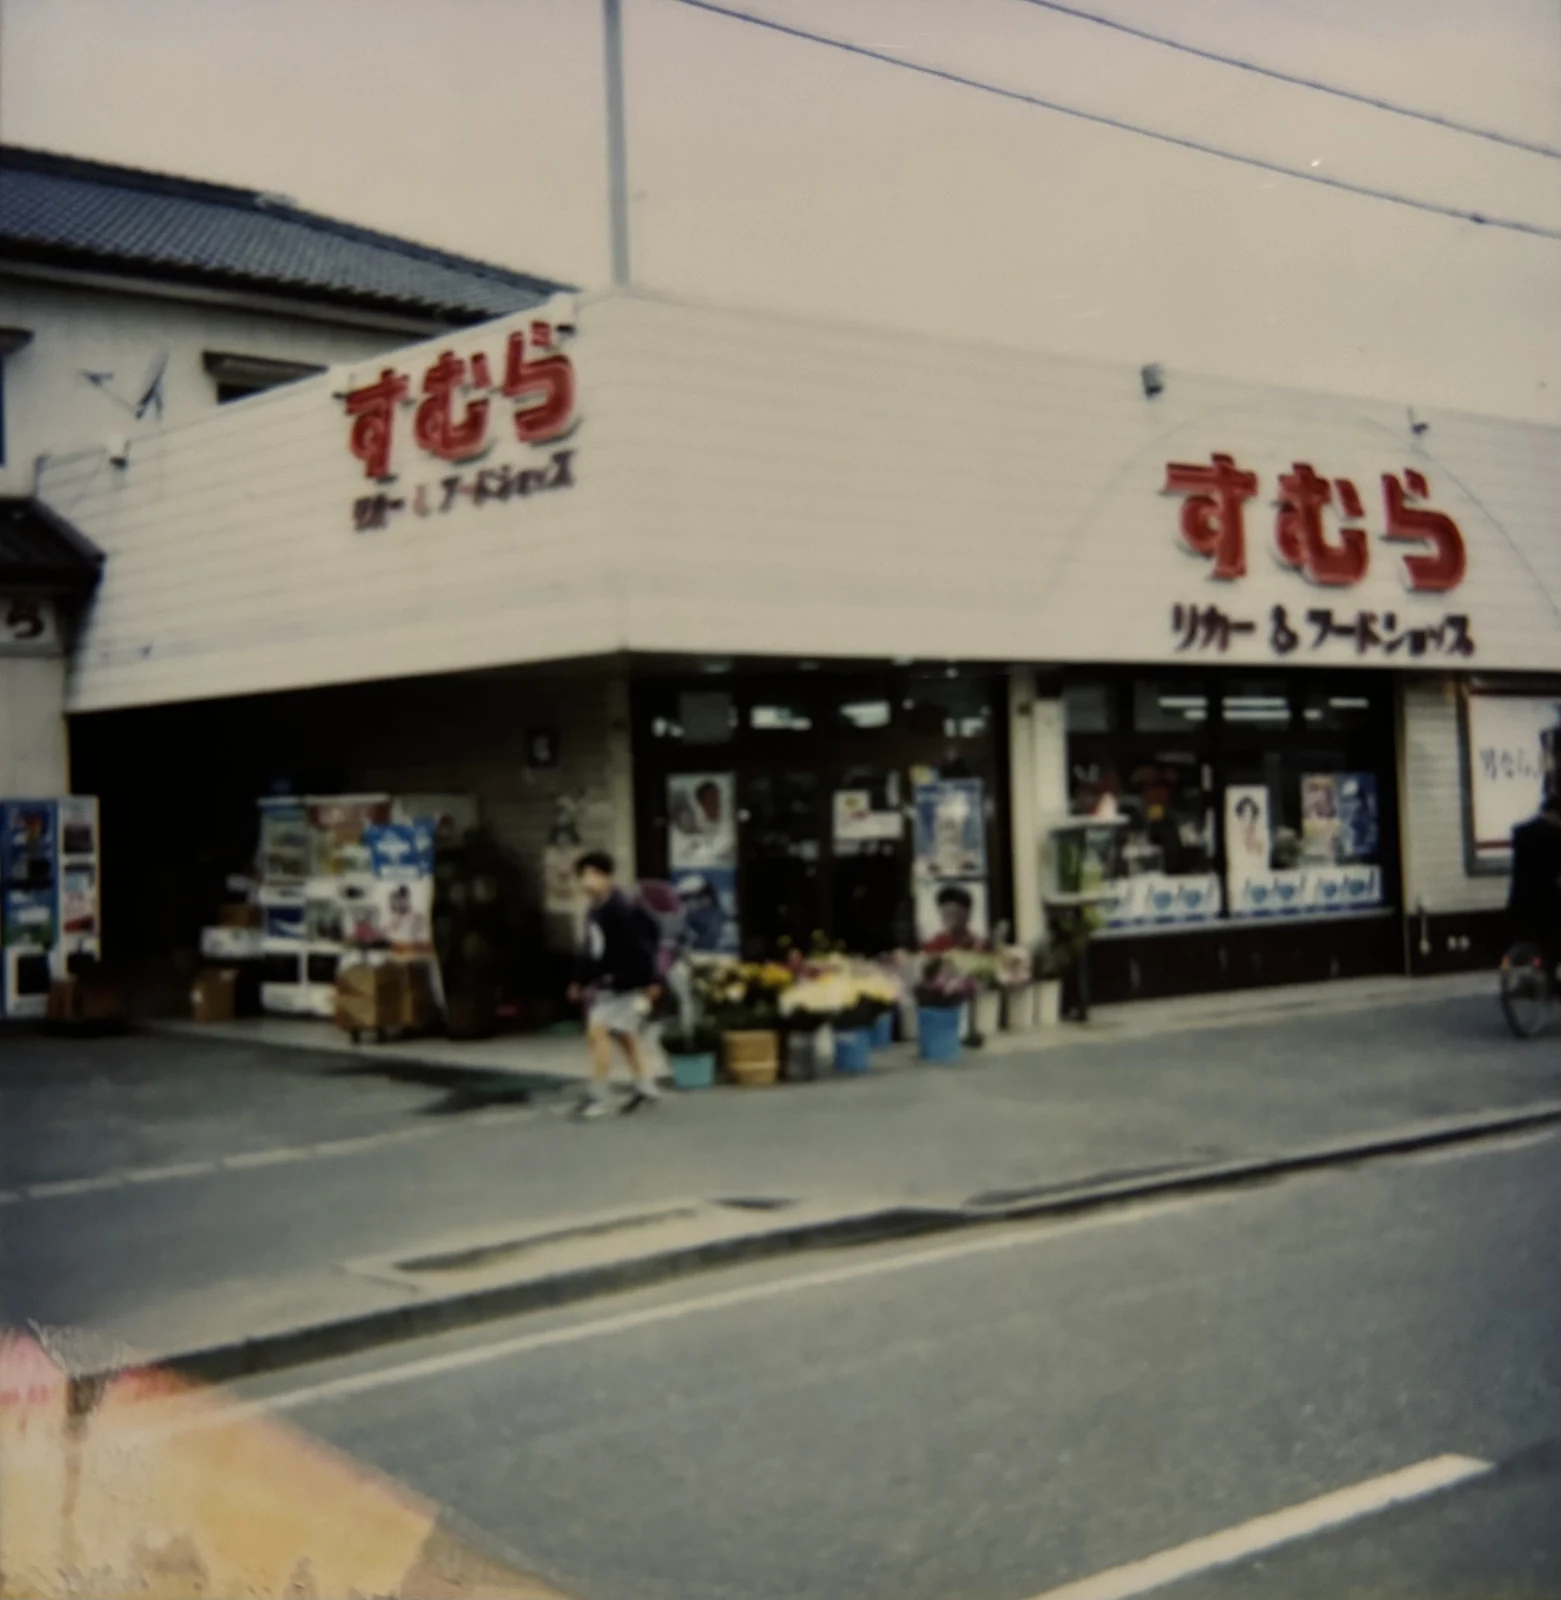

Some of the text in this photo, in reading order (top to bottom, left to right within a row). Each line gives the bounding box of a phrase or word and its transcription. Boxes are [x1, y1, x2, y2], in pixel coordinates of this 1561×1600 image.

[344, 320, 577, 480] すむら
[1165, 452, 1467, 592] すむら
